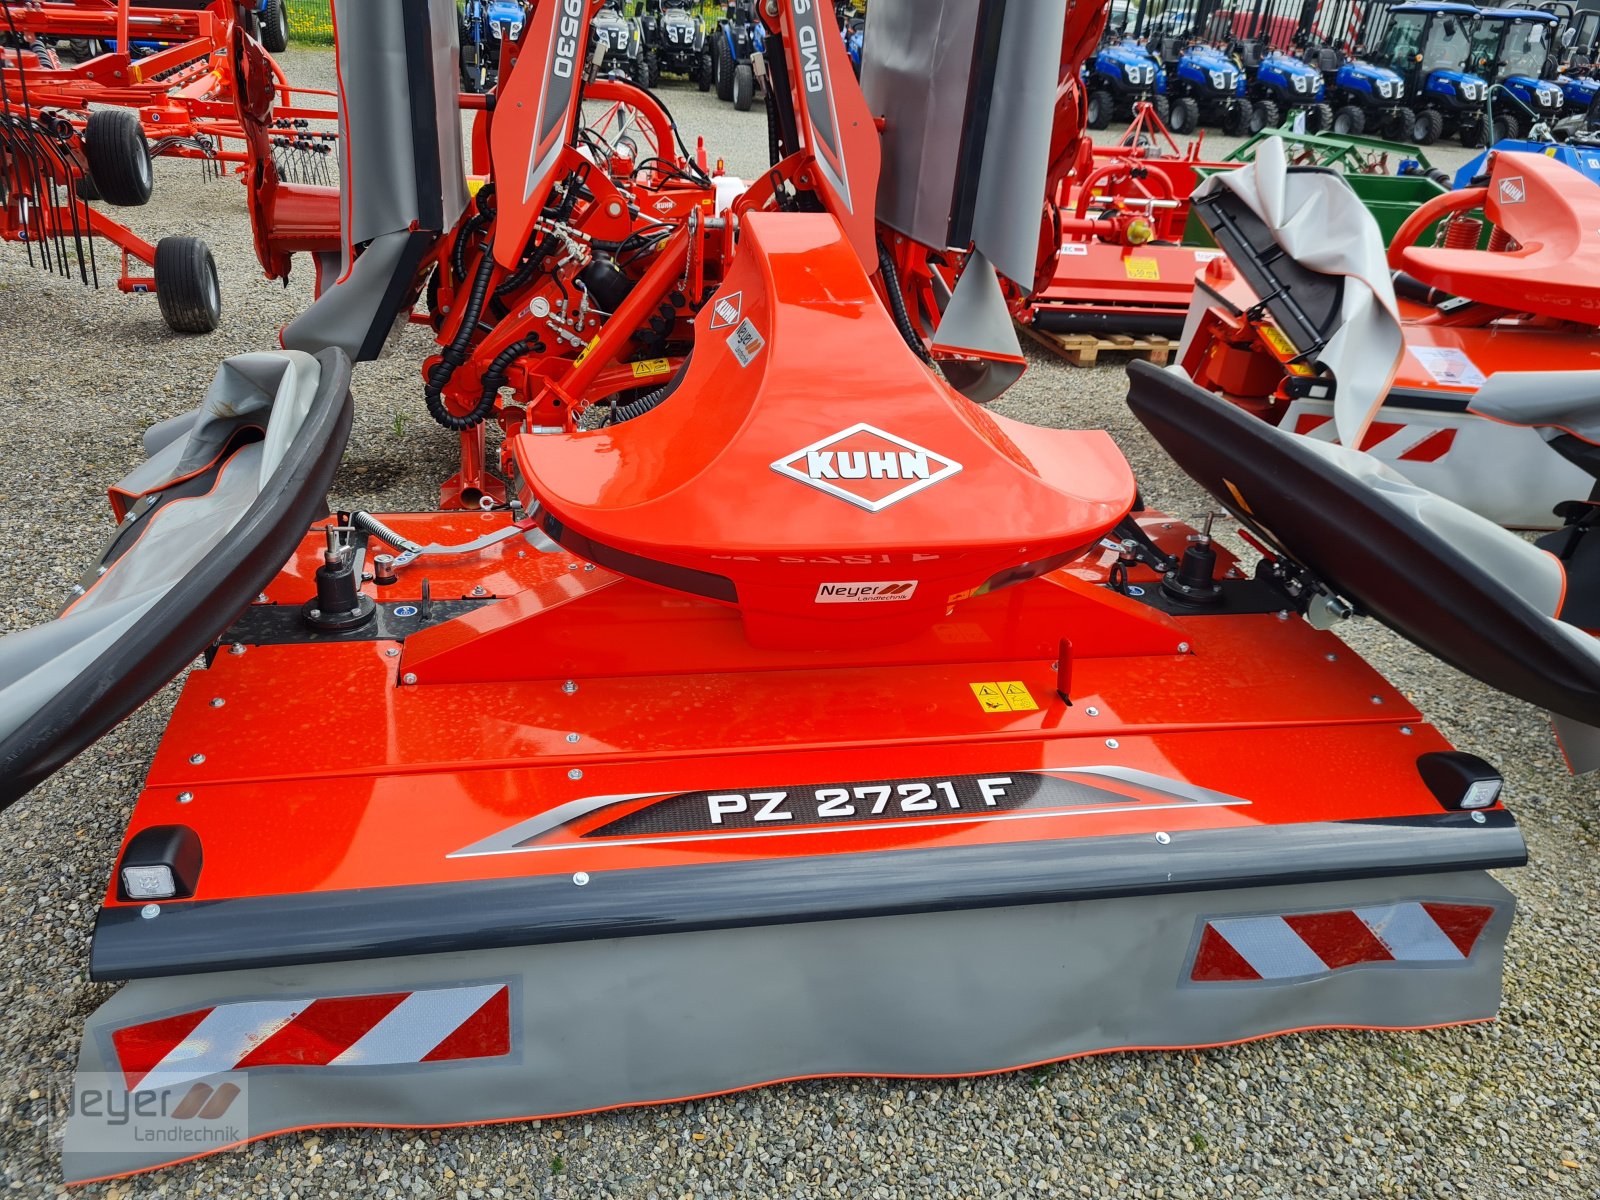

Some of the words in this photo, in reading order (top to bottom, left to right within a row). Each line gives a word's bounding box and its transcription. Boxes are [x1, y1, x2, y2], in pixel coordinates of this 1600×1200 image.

[553, 0, 582, 78] 9530
[799, 25, 823, 92] GMD
[1501, 180, 1523, 201] KUHN
[716, 299, 739, 324] KUHN
[806, 451, 930, 480] KUHN
[820, 585, 879, 597] Neyer
[707, 791, 793, 824] PZ
[814, 781, 961, 818] 2721
[977, 777, 1013, 806] F
